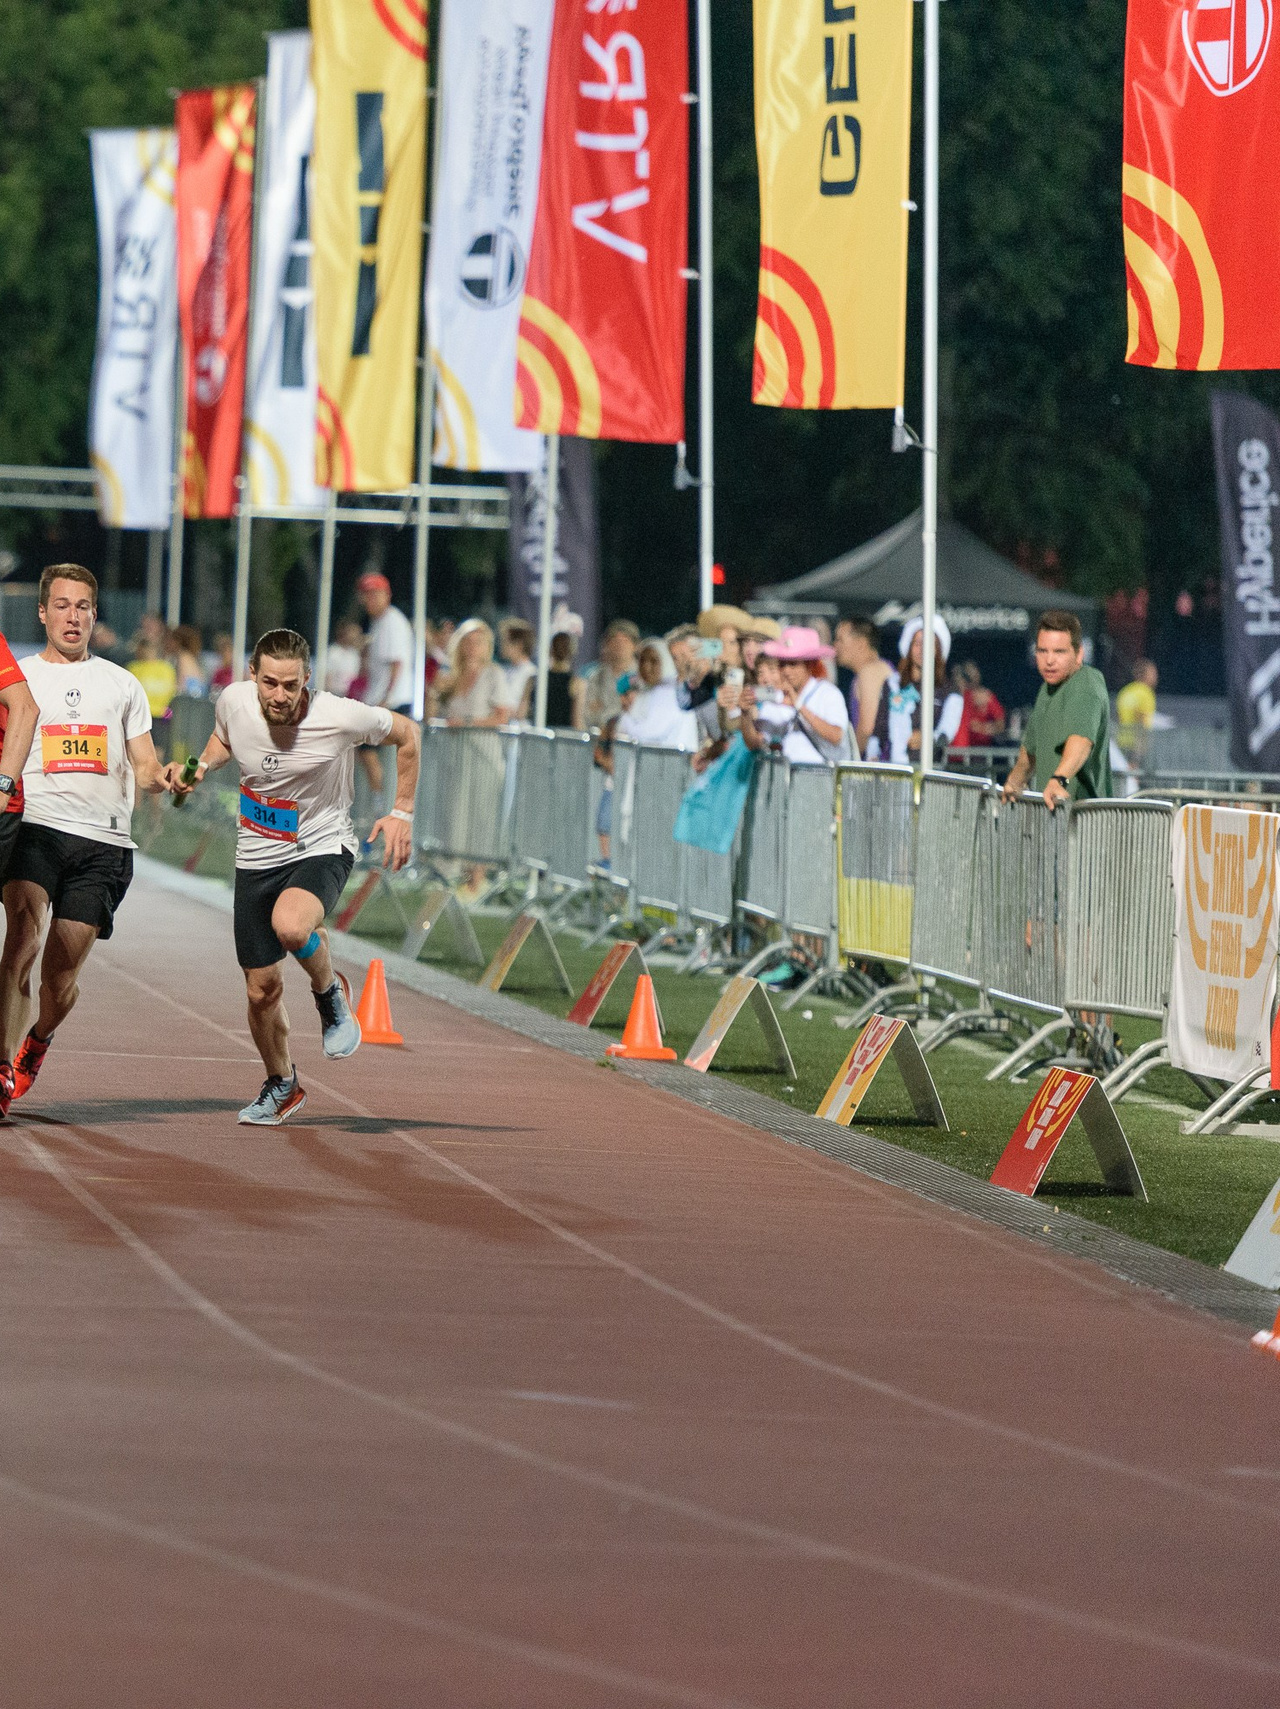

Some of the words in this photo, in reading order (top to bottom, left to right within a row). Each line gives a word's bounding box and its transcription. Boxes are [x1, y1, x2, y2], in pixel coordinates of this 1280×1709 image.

[62, 739, 89, 755] 314
[96, 747, 101, 757] 2
[253, 806, 277, 825] 314
[284, 820, 290, 828] 3
